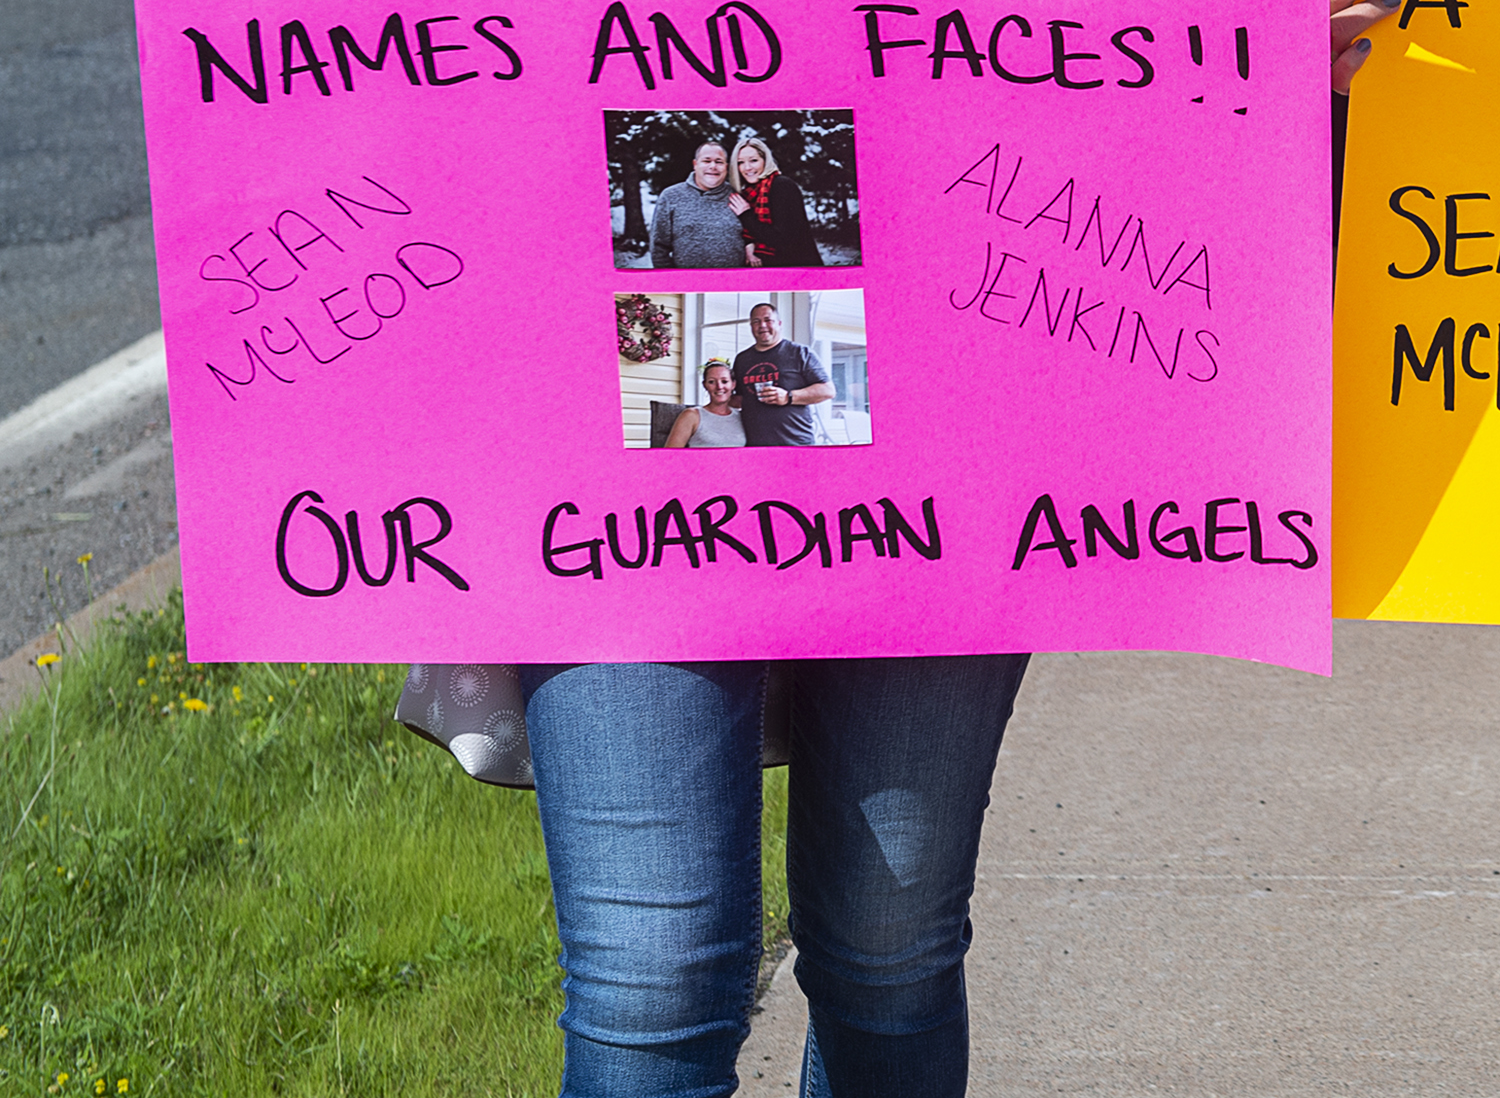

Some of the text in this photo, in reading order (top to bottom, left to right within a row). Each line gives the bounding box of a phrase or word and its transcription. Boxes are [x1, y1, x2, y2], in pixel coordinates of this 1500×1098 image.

[181, 11, 523, 104] NAMES
[588, 0, 783, 91] AND
[199, 174, 413, 316] SEAN
[943, 142, 1212, 311] ALANNA
[205, 241, 464, 402] McLEOD
[948, 241, 1221, 383] JENKINS
[274, 488, 1319, 598] OUR GUARDIAN ANGELS
